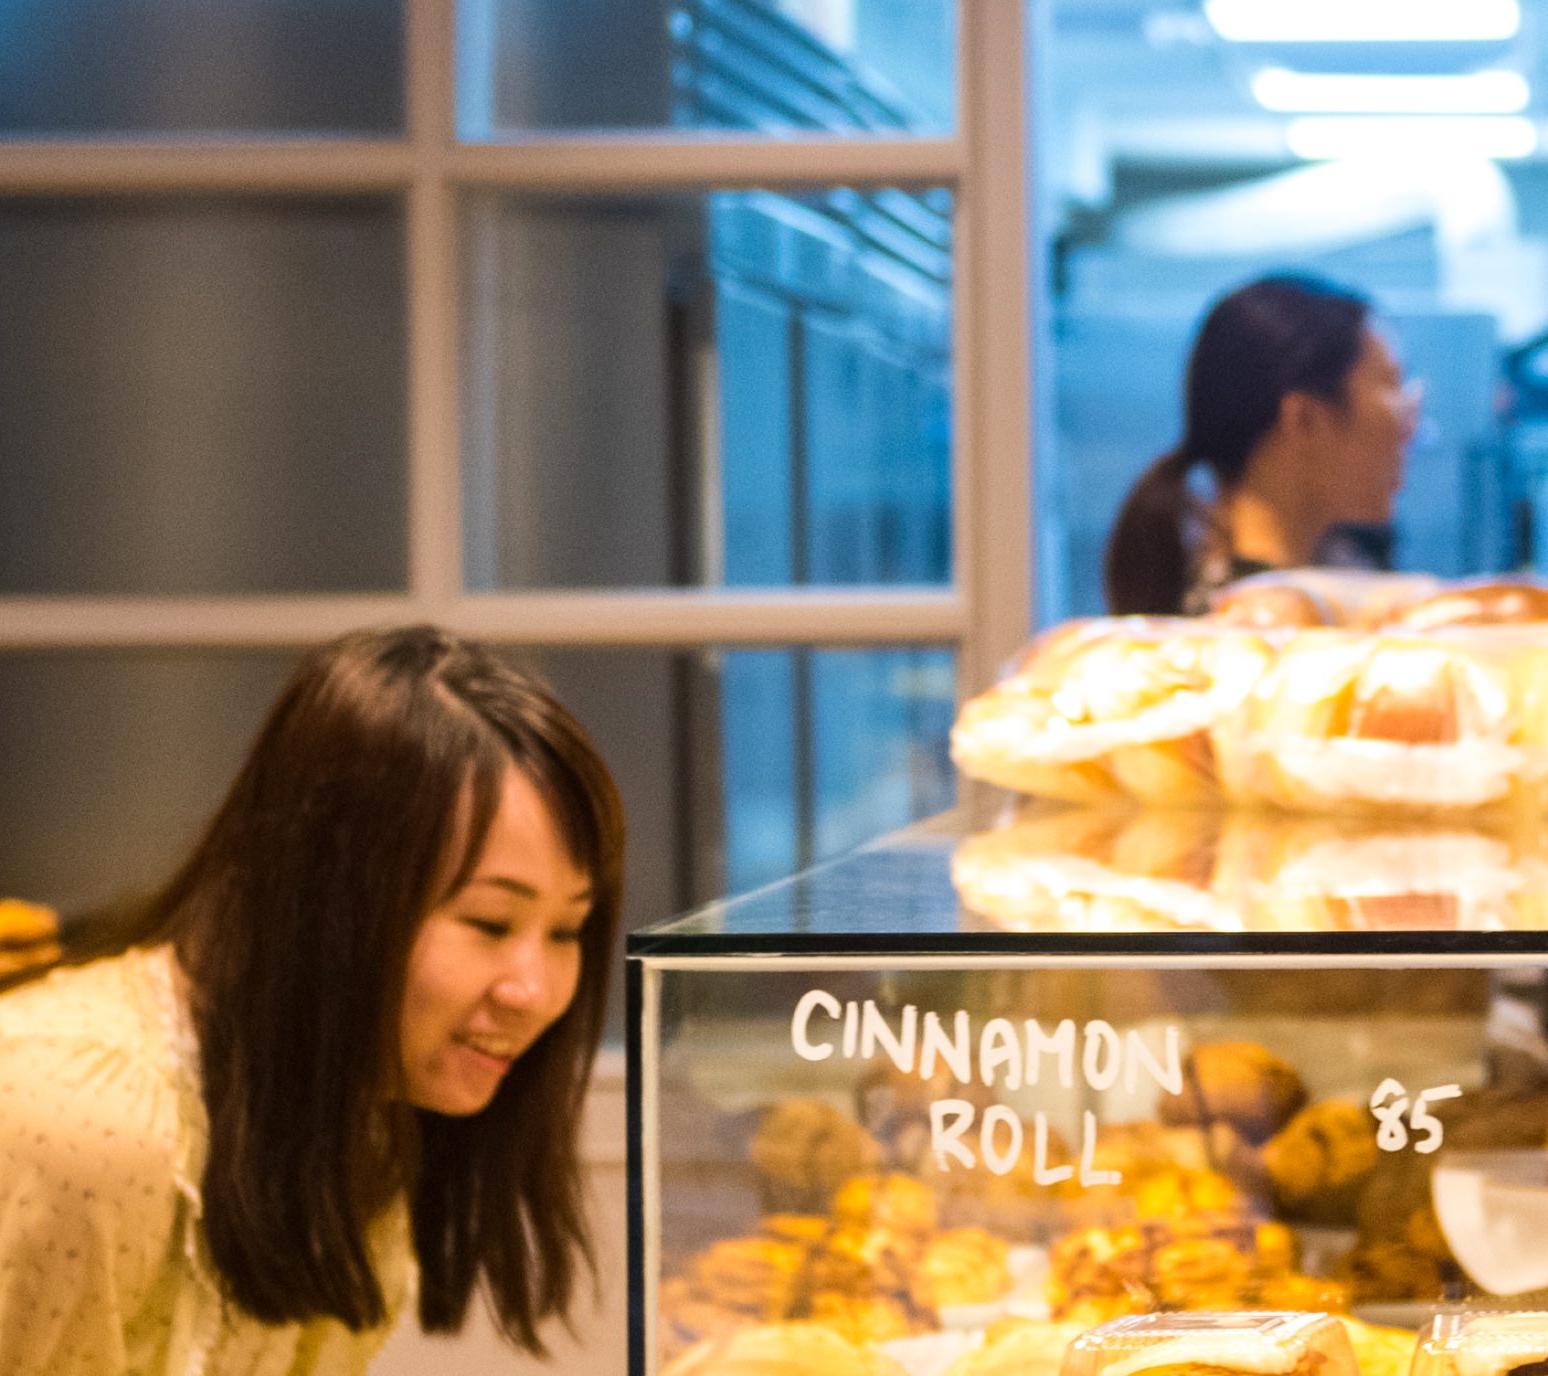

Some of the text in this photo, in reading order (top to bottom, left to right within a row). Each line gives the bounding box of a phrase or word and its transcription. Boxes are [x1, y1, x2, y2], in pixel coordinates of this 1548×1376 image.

[791, 989, 1184, 1095] CINNAMON
[929, 1099, 1122, 1186] ROLL
[1369, 1077, 1463, 1154] 85
